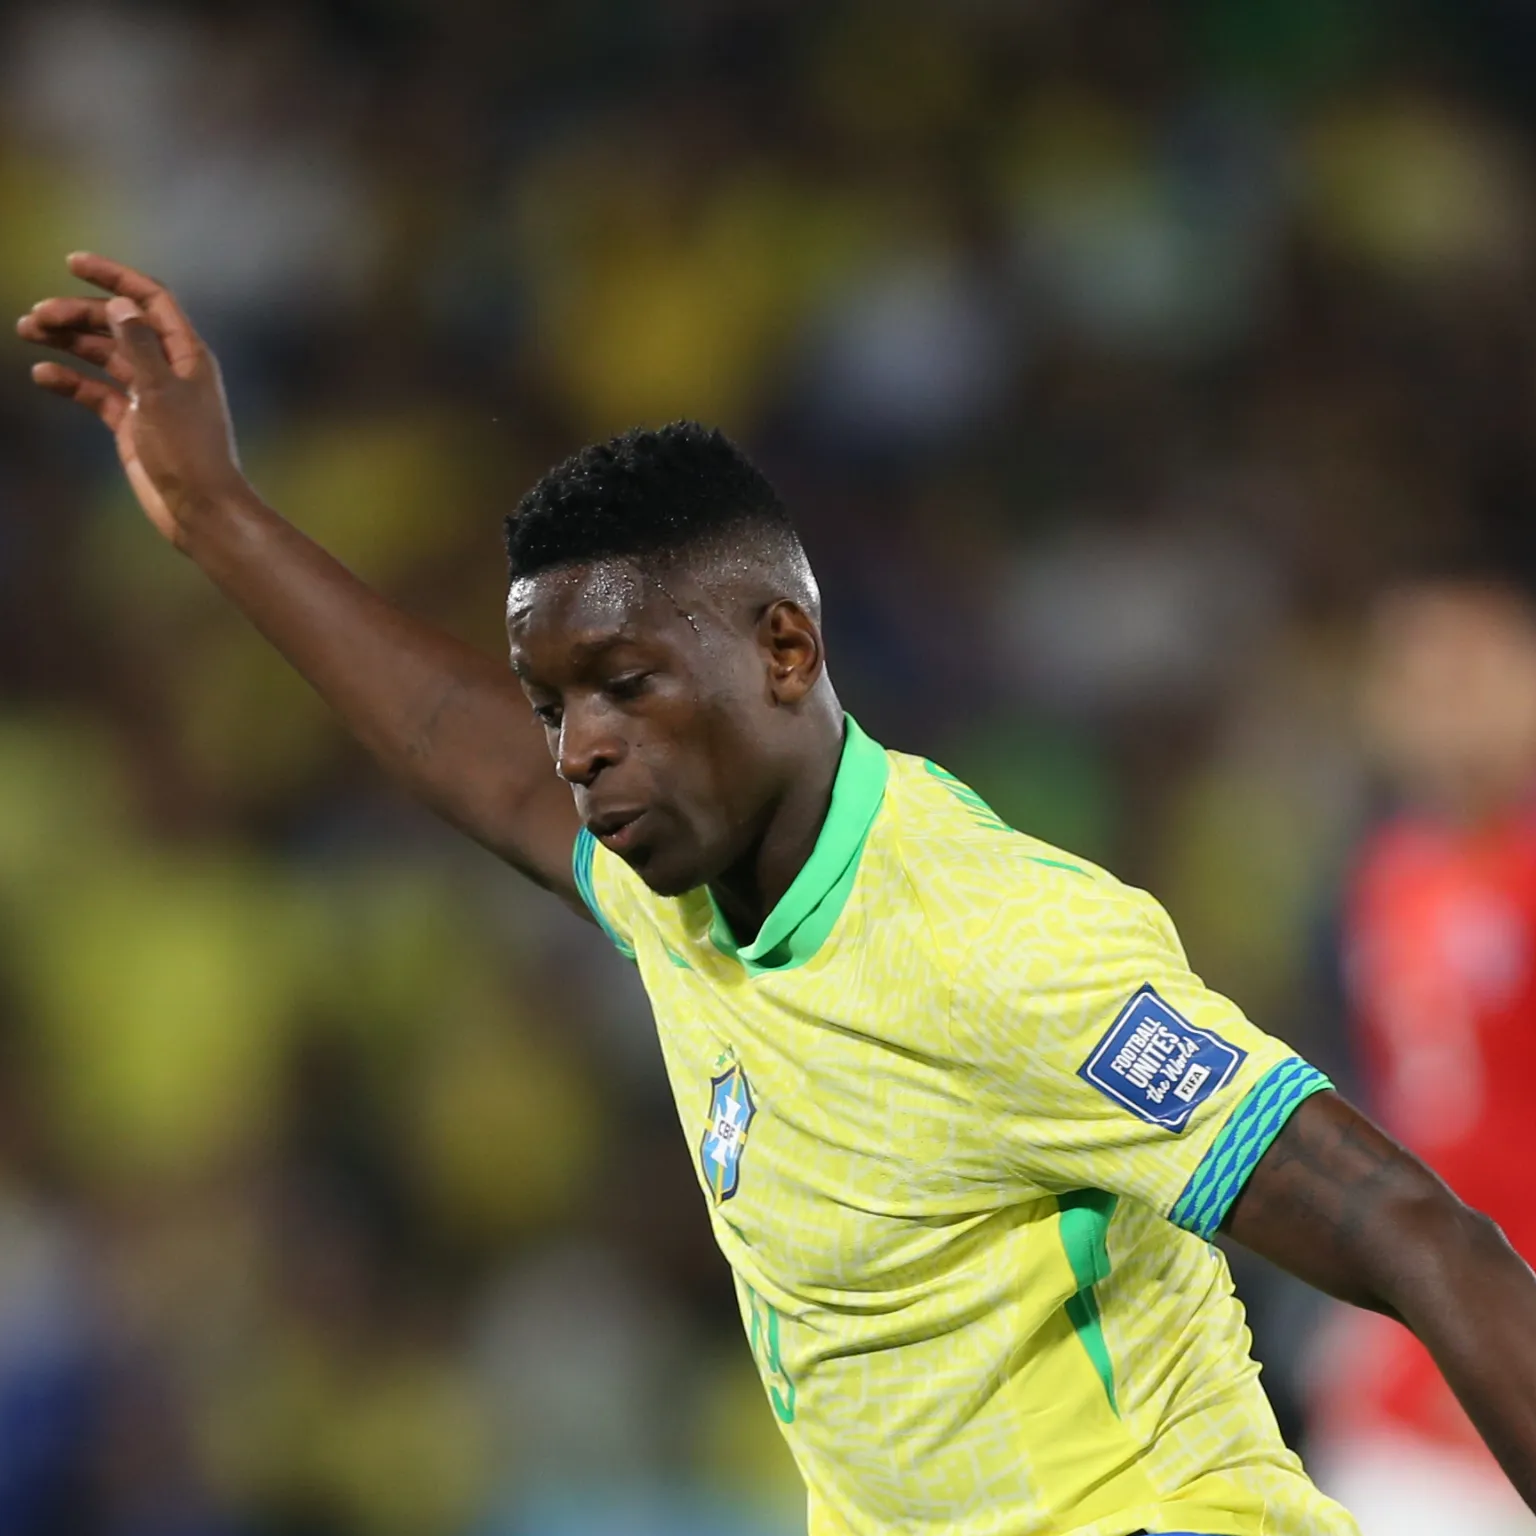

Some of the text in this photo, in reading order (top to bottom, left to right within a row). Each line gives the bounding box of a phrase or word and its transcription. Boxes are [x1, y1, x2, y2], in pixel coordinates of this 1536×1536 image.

[1110, 1016, 1161, 1075] FOOTBALL
[1125, 1026, 1180, 1088] UNITES
[1146, 1036, 1200, 1104] the World
[1181, 1071, 1203, 1095] FIFA
[717, 1120, 735, 1142] CBF
